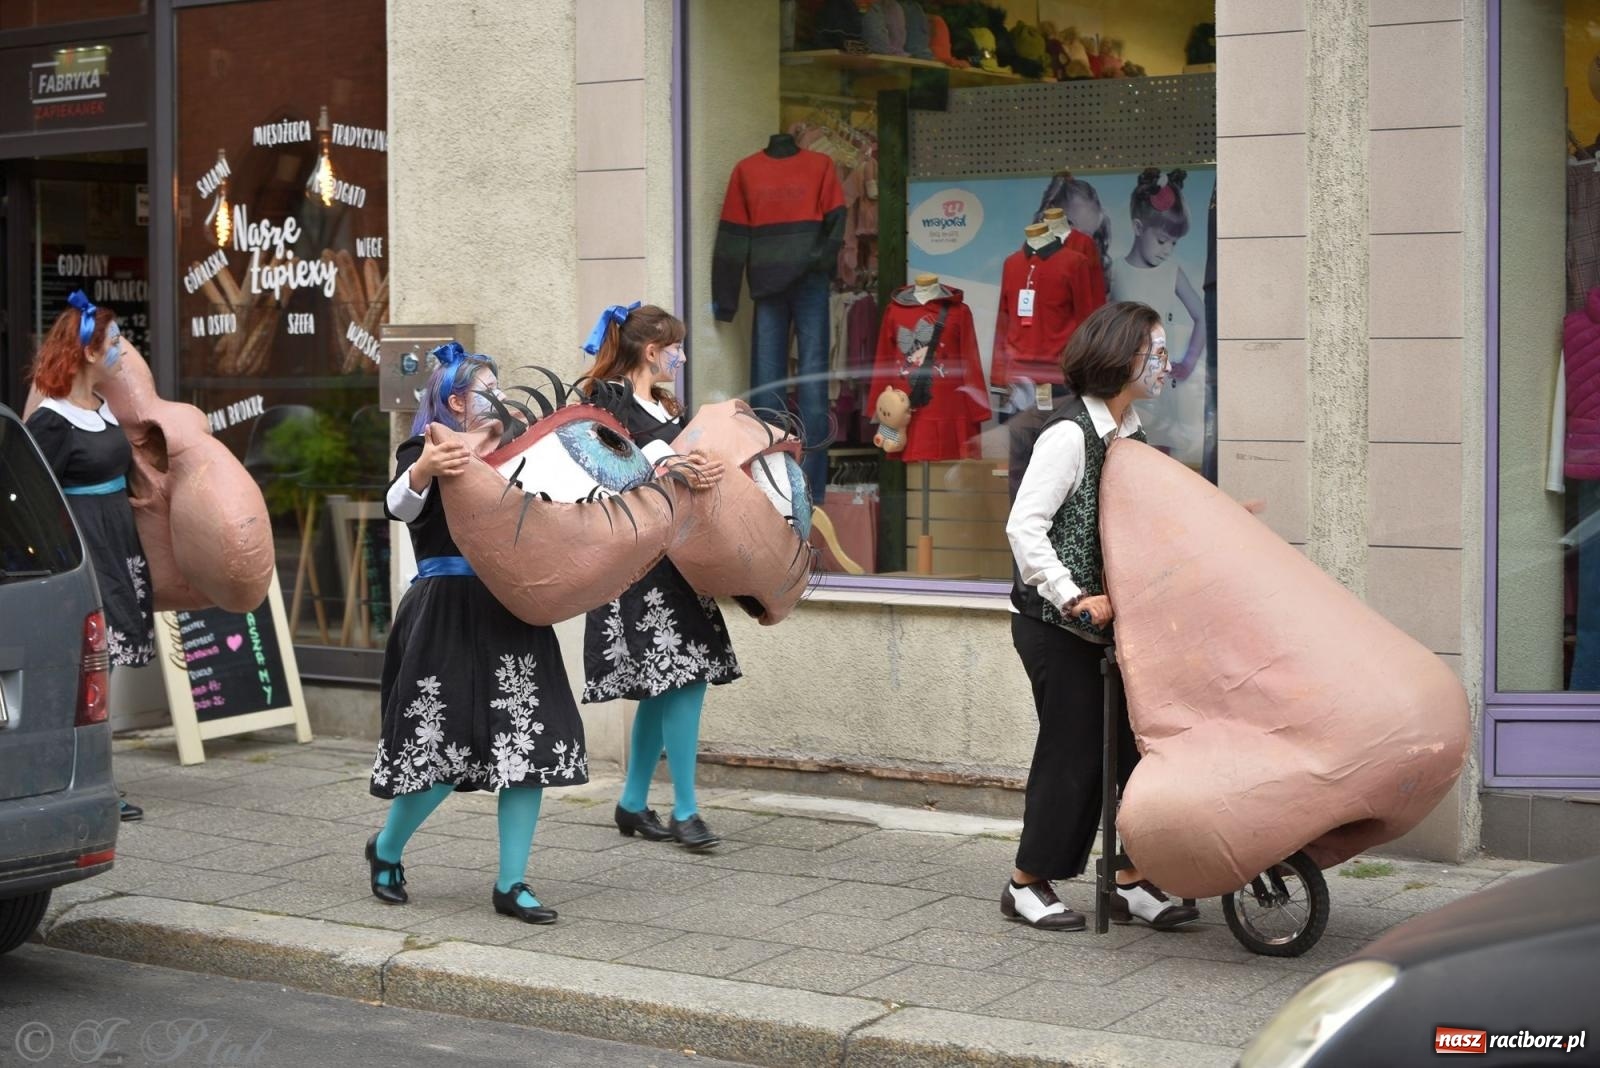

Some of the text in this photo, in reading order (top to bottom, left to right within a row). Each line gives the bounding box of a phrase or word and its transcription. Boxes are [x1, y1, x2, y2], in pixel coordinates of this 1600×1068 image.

[38, 68, 101, 94] FABRYKA
[34, 102, 105, 119] ZAPIEKANEK
[253, 118, 311, 147] MIĘSOŻERCA
[196, 158, 232, 200] SALAMI
[233, 203, 302, 260] Nasze
[922, 214, 967, 230] mayoral
[356, 237, 384, 258] WEGE
[58, 254, 110, 277] GODZINY
[184, 249, 229, 294] GÓRALSKA
[94, 279, 149, 302] OTWARCI
[192, 313, 238, 337] NA OSTRO
[287, 313, 316, 335] SZEFA
